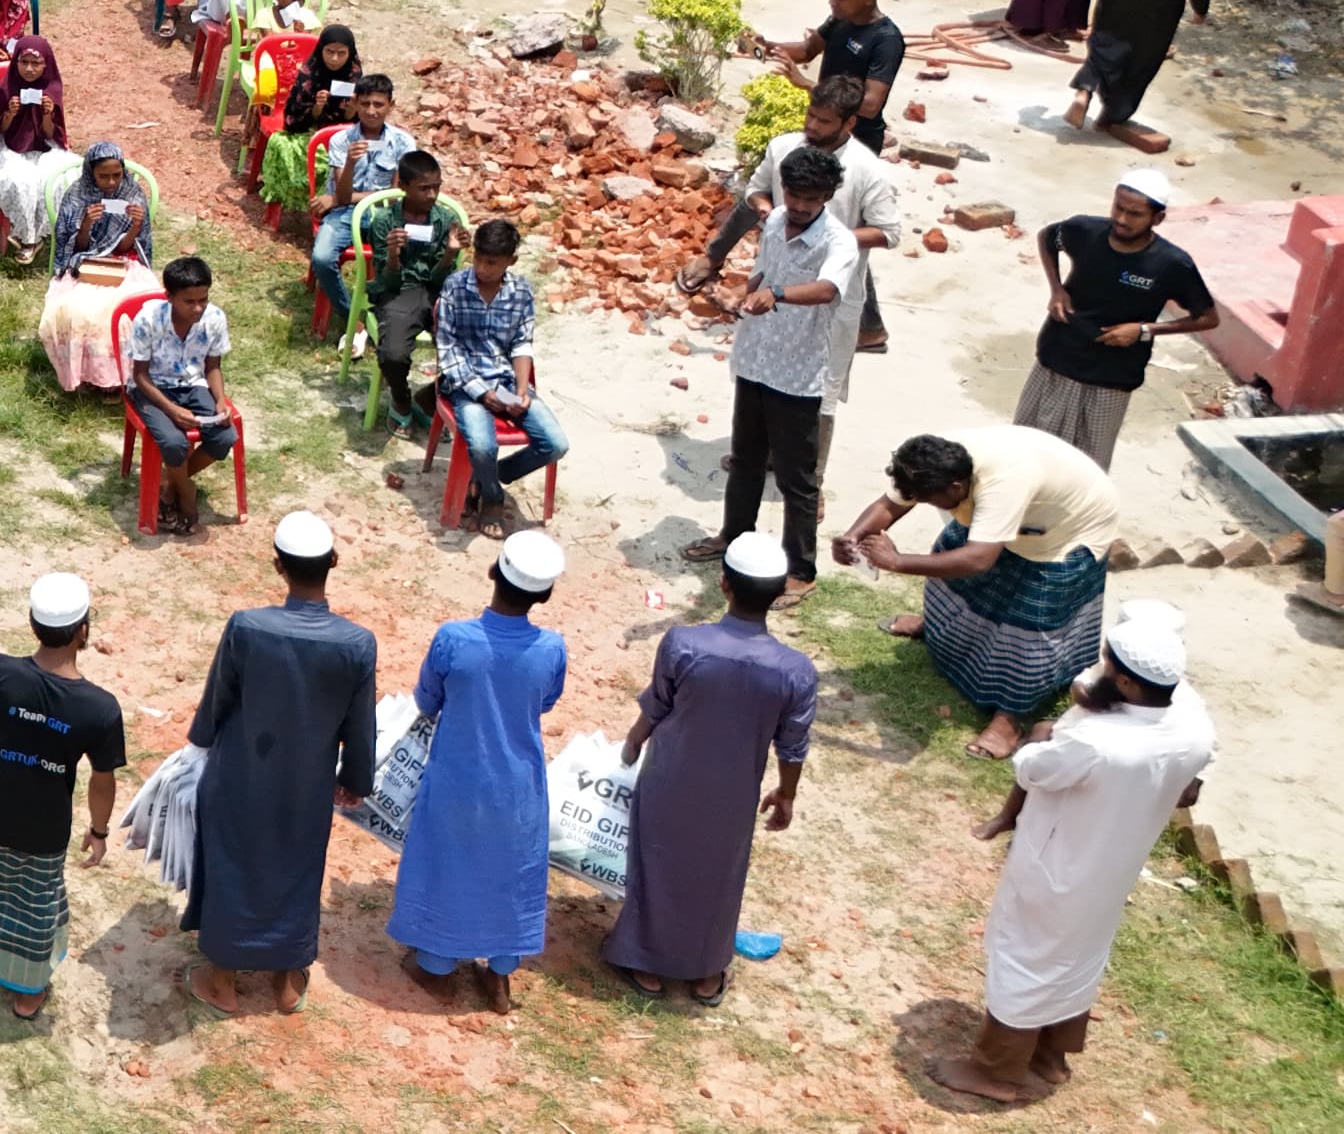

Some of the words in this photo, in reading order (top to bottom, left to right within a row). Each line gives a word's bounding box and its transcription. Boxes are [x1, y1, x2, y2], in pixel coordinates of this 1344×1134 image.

[1129, 274, 1153, 286] GRT
[372, 785, 403, 818] WBS
[594, 777, 632, 809] GR
[380, 822, 408, 843] WB
[559, 800, 593, 824] EID
[597, 817, 630, 840] GIF
[559, 818, 627, 852] DISTRIBUTIO
[591, 862, 628, 887] WBS
